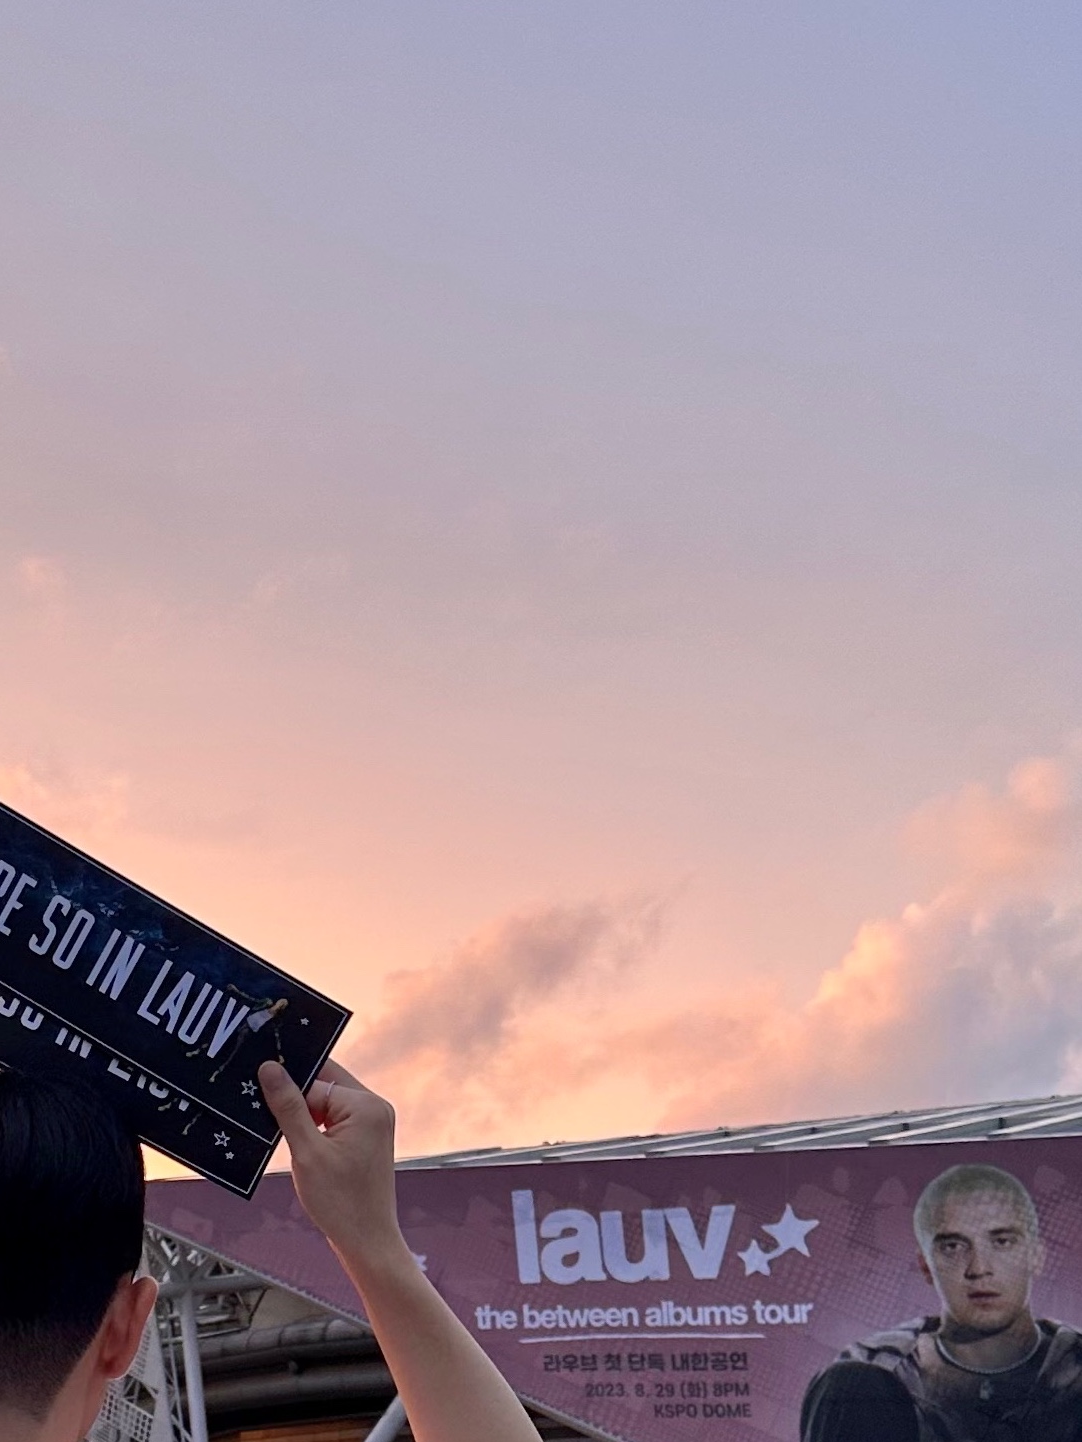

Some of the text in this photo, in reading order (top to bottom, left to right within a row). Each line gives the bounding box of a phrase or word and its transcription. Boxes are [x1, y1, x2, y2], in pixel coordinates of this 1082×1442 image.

[29, 894, 95, 970] SO
[86, 929, 146, 999] IN
[138, 960, 249, 1057] LAUV
[511, 1190, 736, 1285] lauv
[475, 1300, 813, 1330] the between albums tour
[543, 1352, 748, 1372] 라우브 첫 단독 내한공연
[713, 1383, 750, 1398] 8PM
[654, 1403, 752, 1419] KSPO DOME
